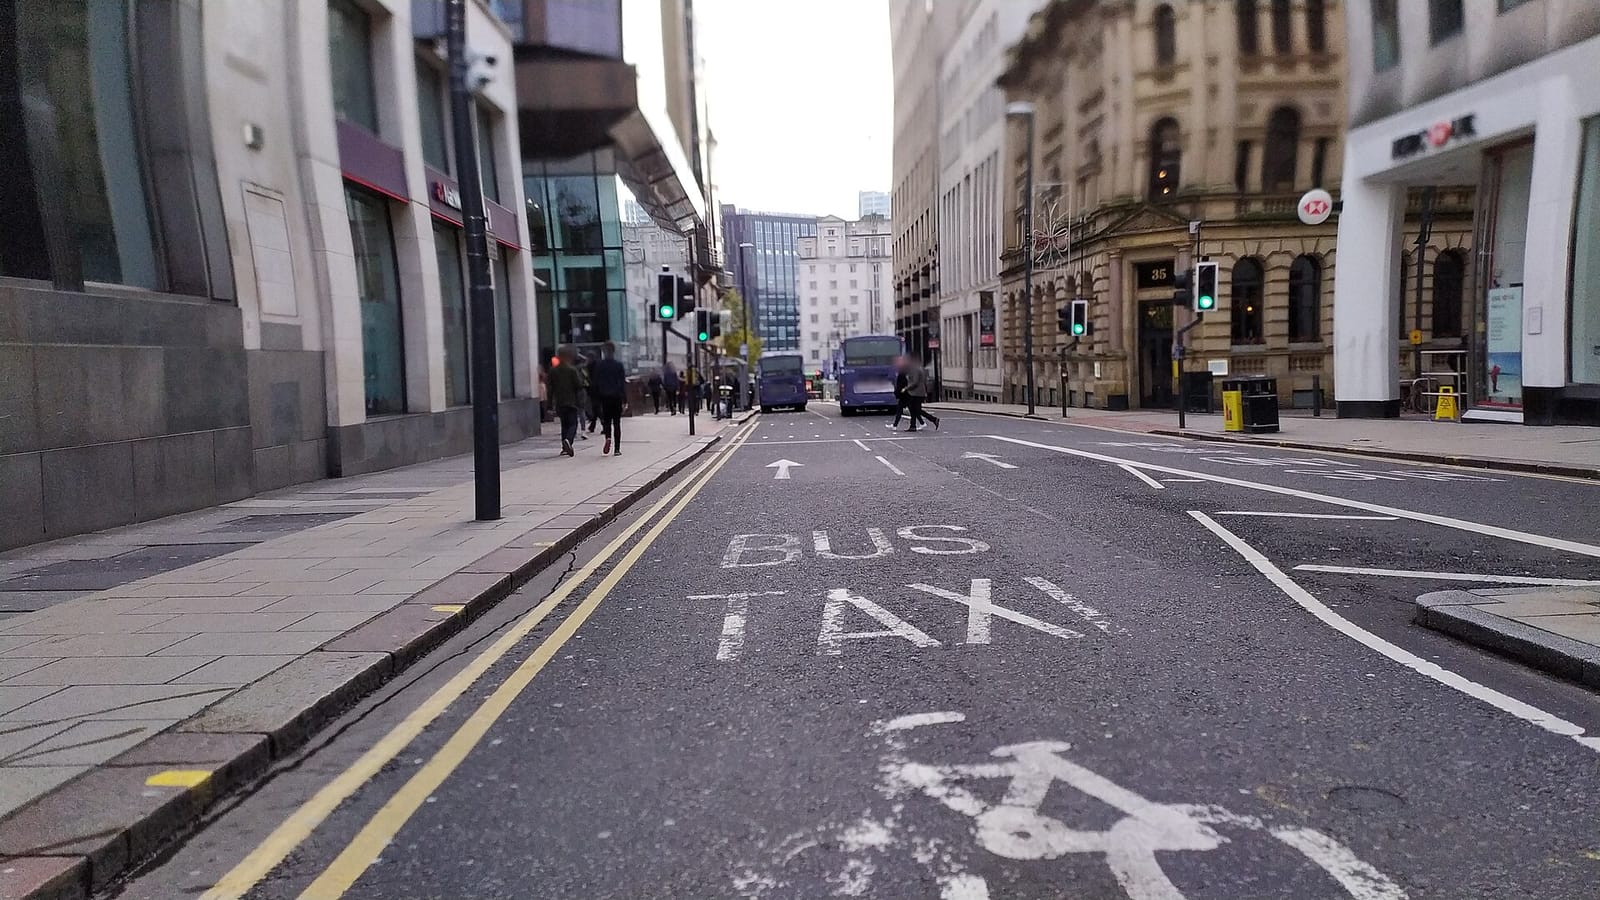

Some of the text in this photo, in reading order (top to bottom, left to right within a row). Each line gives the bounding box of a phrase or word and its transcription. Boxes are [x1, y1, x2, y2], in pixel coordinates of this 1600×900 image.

[1152, 268, 1167, 280] 35
[1284, 470, 1507, 482] BUS
[720, 524, 992, 569] BUS
[686, 577, 1113, 661] TAXI
